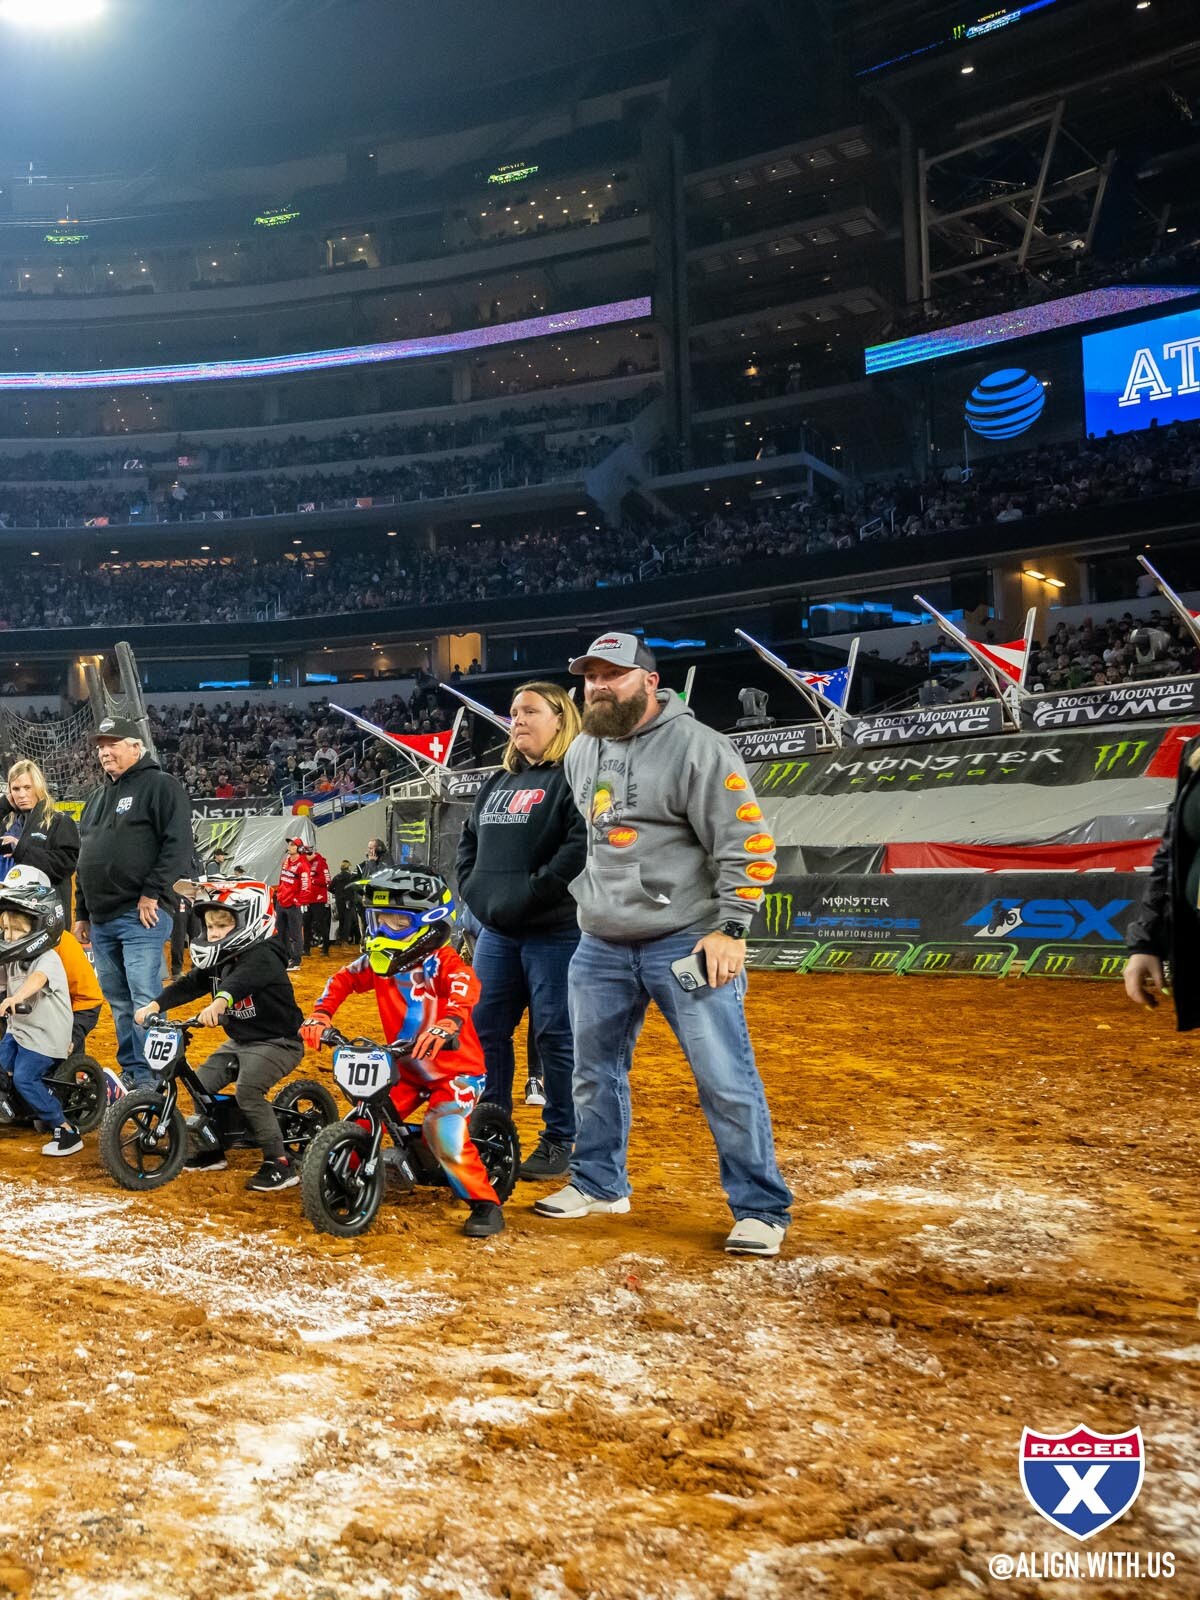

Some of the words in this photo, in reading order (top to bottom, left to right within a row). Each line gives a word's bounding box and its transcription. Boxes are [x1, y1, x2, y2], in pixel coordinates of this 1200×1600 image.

[1055, 693, 1106, 709] ROCKY
[1106, 681, 1195, 703] MOUNTAIN
[873, 714, 915, 729] ROCKY
[916, 706, 990, 723] MOUNTAIN
[744, 729, 806, 745] MOUNTAIN
[825, 748, 1064, 776] MONSTER
[461, 773, 488, 783] ROCKY
[850, 767, 1017, 785] ENERGY
[507, 788, 546, 814] UP
[579, 776, 592, 805] TACO
[627, 783, 638, 808] DAY
[192, 804, 275, 819] NSTER
[500, 813, 530, 824] FACILITY
[822, 895, 889, 908] MONSTER
[794, 916, 921, 930] SUPERCROSS
[817, 929, 891, 939] CHAMPIONSHIP
[447, 971, 471, 1008] FOX
[427, 1026, 448, 1038] FOX
[148, 1040, 173, 1061] 102
[348, 1062, 380, 1087] 101
